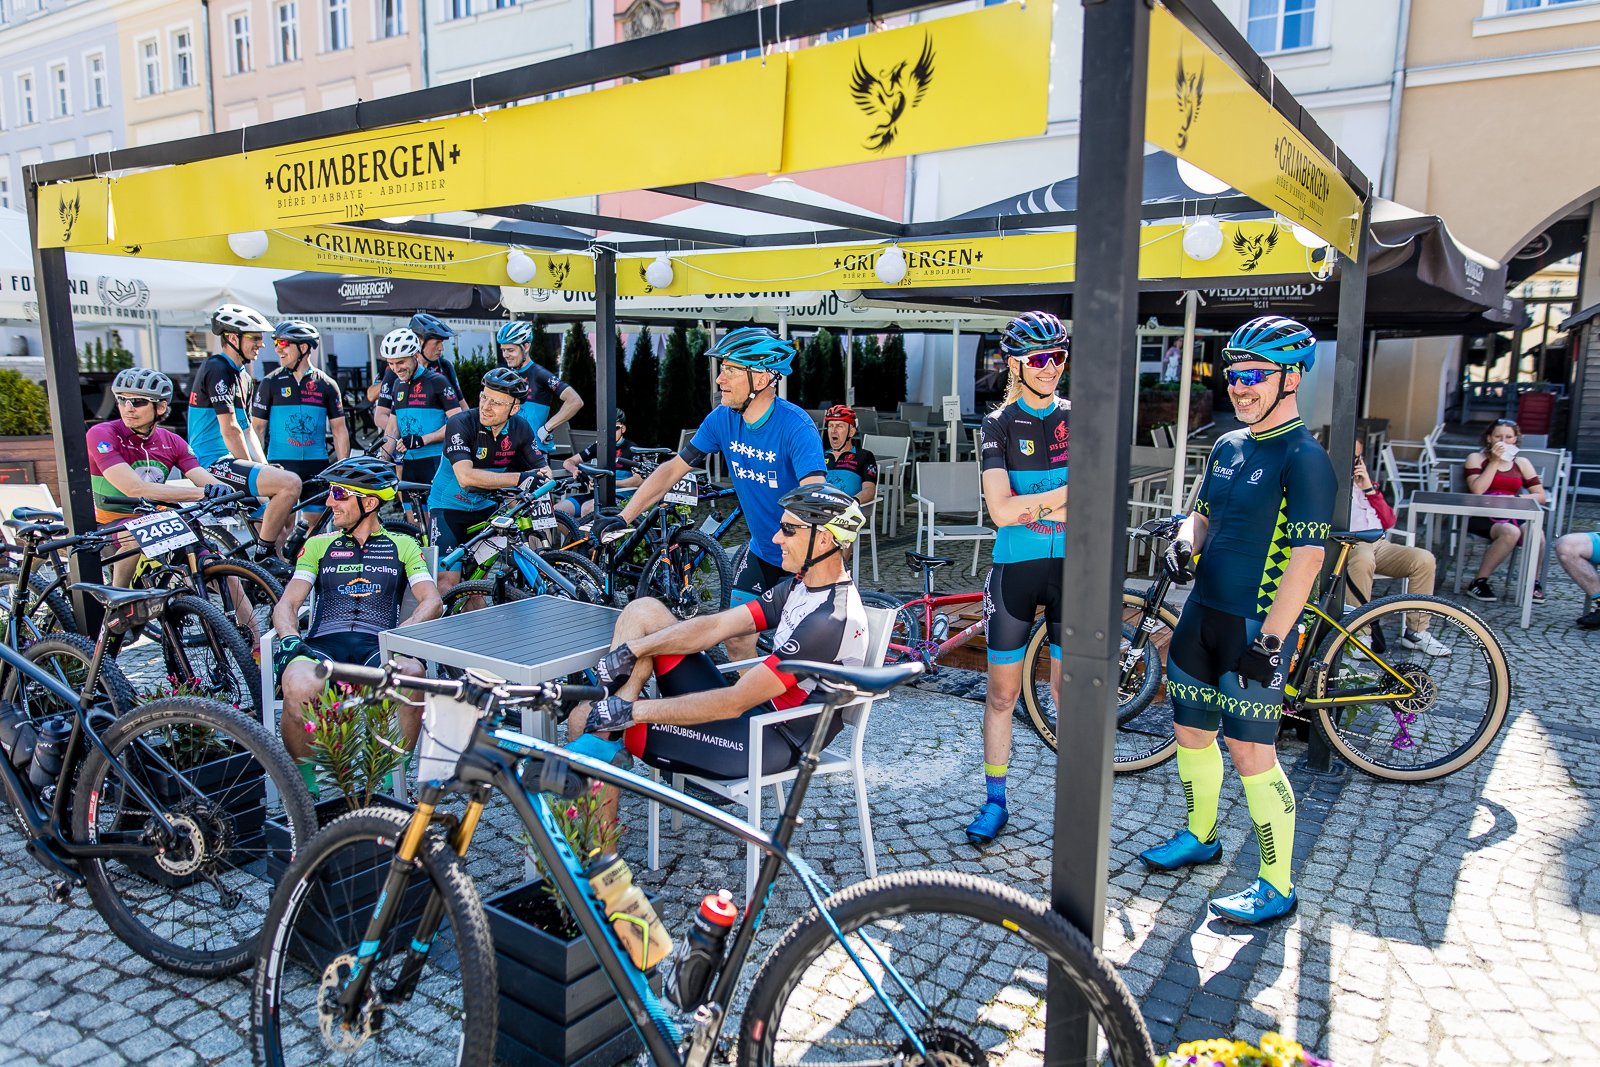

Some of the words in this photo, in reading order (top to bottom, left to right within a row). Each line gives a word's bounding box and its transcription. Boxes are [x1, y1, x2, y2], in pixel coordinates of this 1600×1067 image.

[277, 140, 445, 193] GRIMBERGEN
[1279, 136, 1328, 202] GRIMBERGEN
[278, 196, 306, 208] BIÈRE
[312, 189, 363, 205] D'ABBAYE
[380, 179, 446, 196] ABDIJBIER
[345, 204, 365, 218] 1128
[316, 233, 446, 262] GRIMBERGEN
[377, 266, 393, 274] 1128
[843, 249, 972, 271] GRIERGEN
[12, 275, 89, 295] FONA
[340, 281, 391, 297] GRIMBERGEN
[1059, 441, 1069, 449] EXT
[1220, 467, 1235, 476] PLUS
[834, 517, 849, 525] 700
[136, 519, 184, 544] 2465
[322, 566, 336, 574] We
[364, 565, 398, 575] Cycling
[1143, 616, 1156, 627] 32
[659, 724, 701, 740] MITSUBISHI
[702, 735, 744, 752] MATERIALS
[157, 950, 248, 971] WOLFPACK
